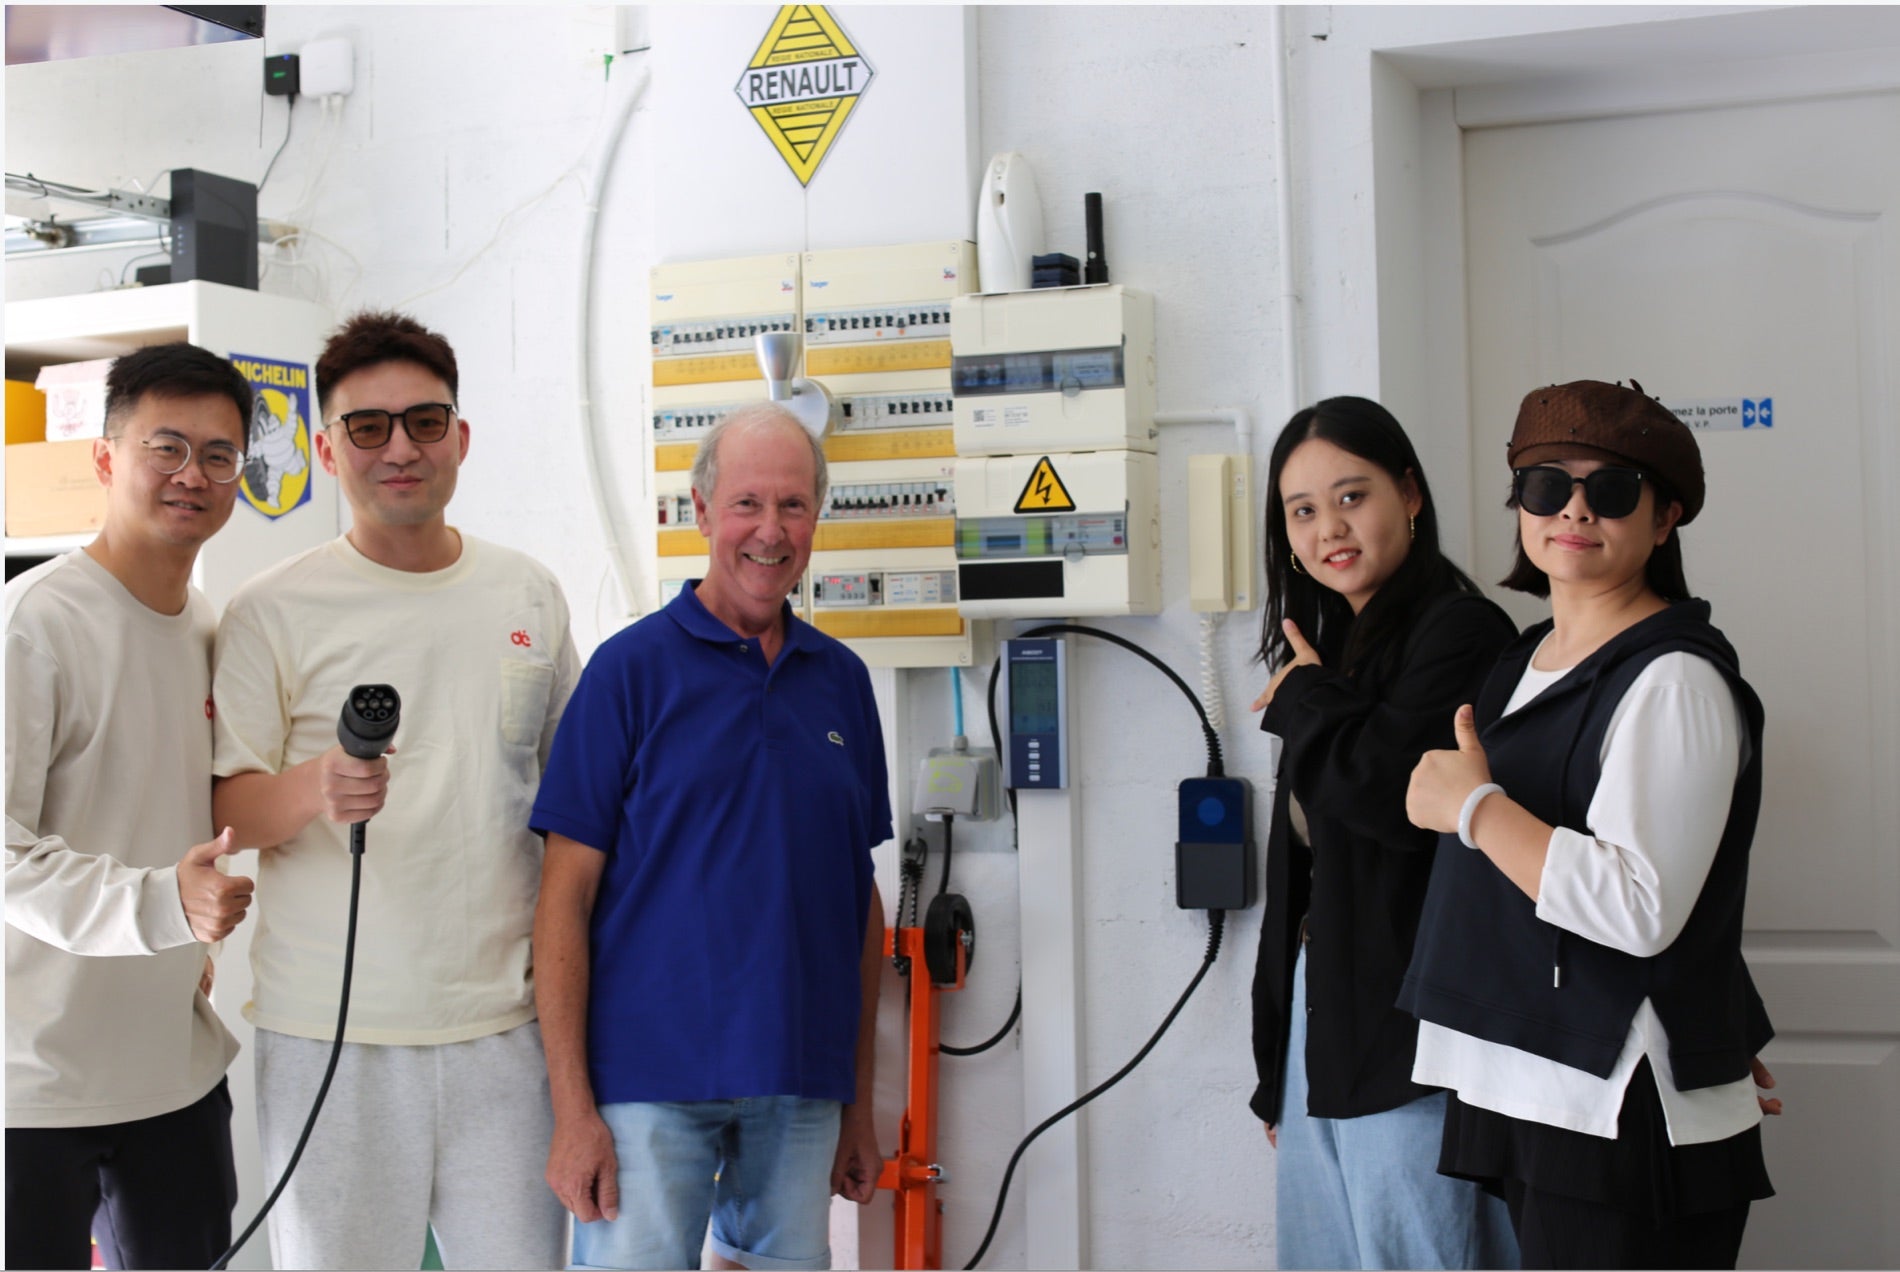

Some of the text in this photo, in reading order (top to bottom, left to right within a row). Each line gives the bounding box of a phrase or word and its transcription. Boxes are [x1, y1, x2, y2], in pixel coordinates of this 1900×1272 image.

[750, 61, 858, 102] RENAULT
[233, 359, 306, 388] MICHELIN
[1696, 406, 1706, 416] la
[1709, 405, 1738, 417] porte
